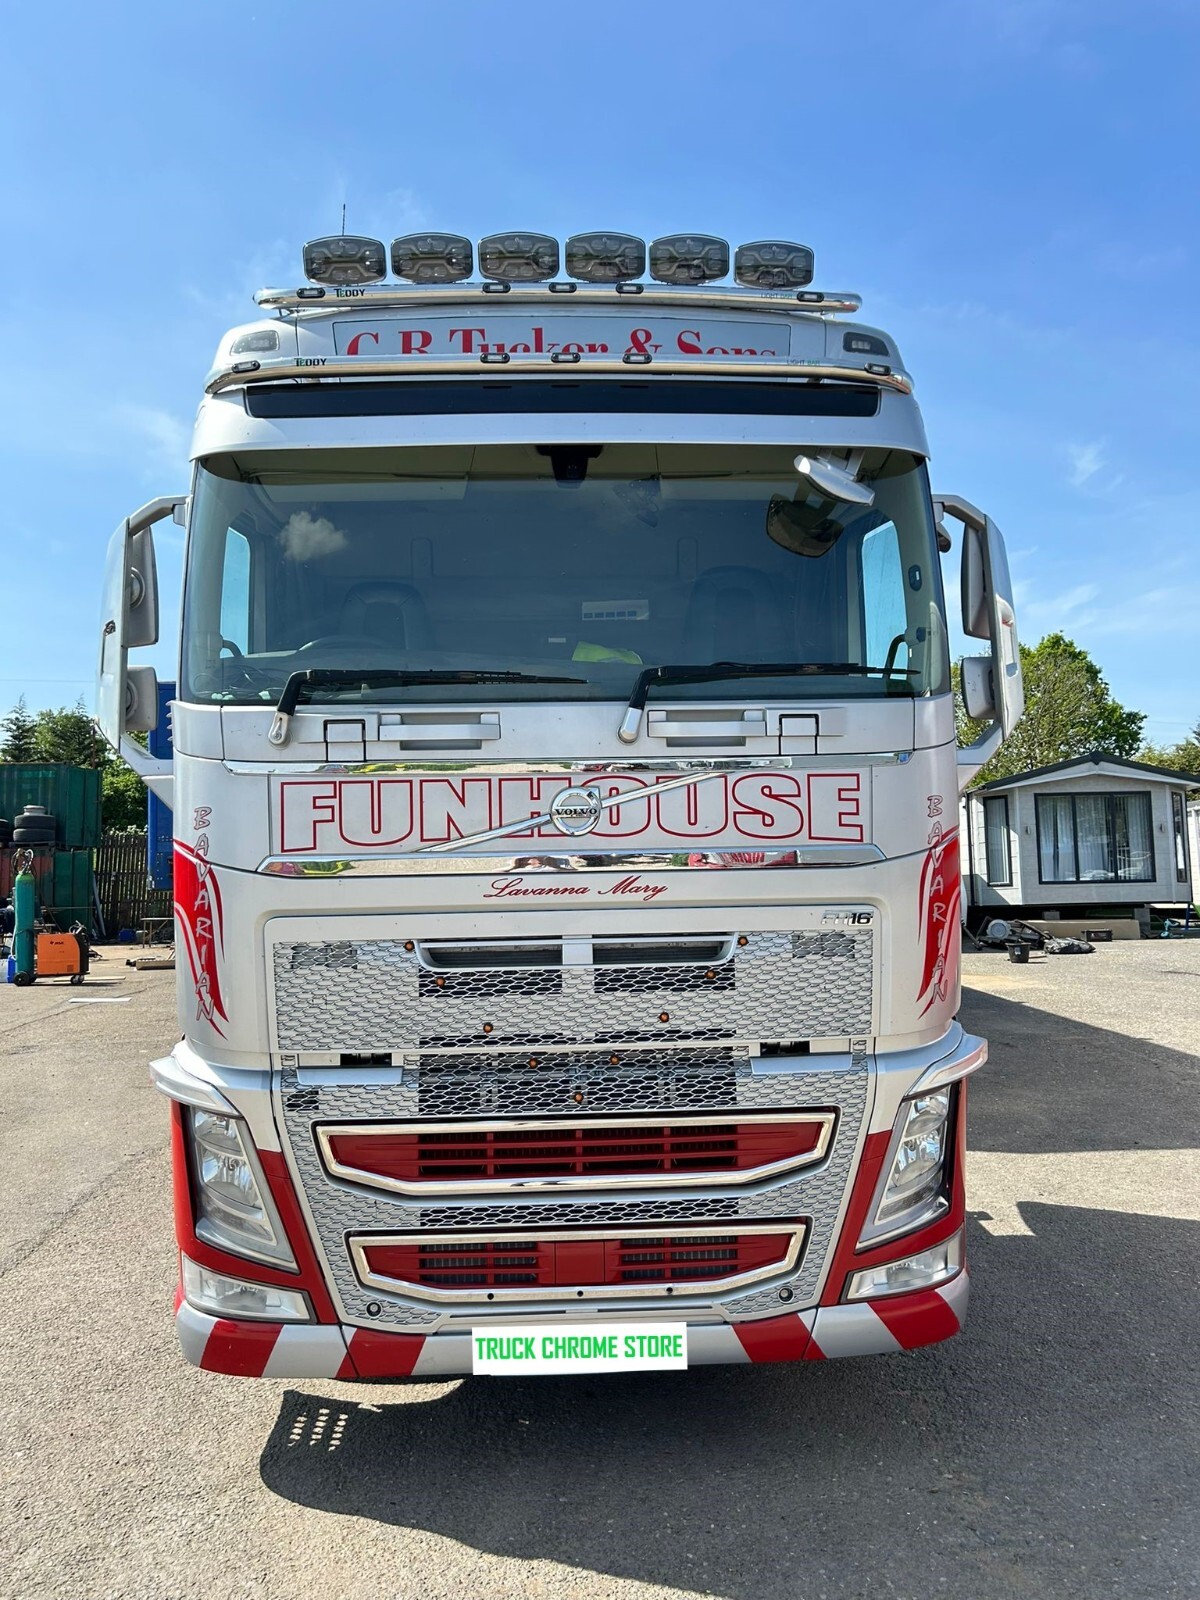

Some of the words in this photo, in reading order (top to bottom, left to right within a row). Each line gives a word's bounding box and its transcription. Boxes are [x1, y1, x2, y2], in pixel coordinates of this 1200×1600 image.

[334, 288, 366, 298] TEDDY
[294, 358, 327, 367] TEDDY
[280, 773, 864, 853] FUNHOUSE
[554, 808, 598, 816] VOLVO
[483, 877, 590, 898] Lavanna
[597, 875, 669, 901] Mary
[927, 794, 948, 1005] BAVARIAN
[193, 806, 215, 1022] BAVARIAN
